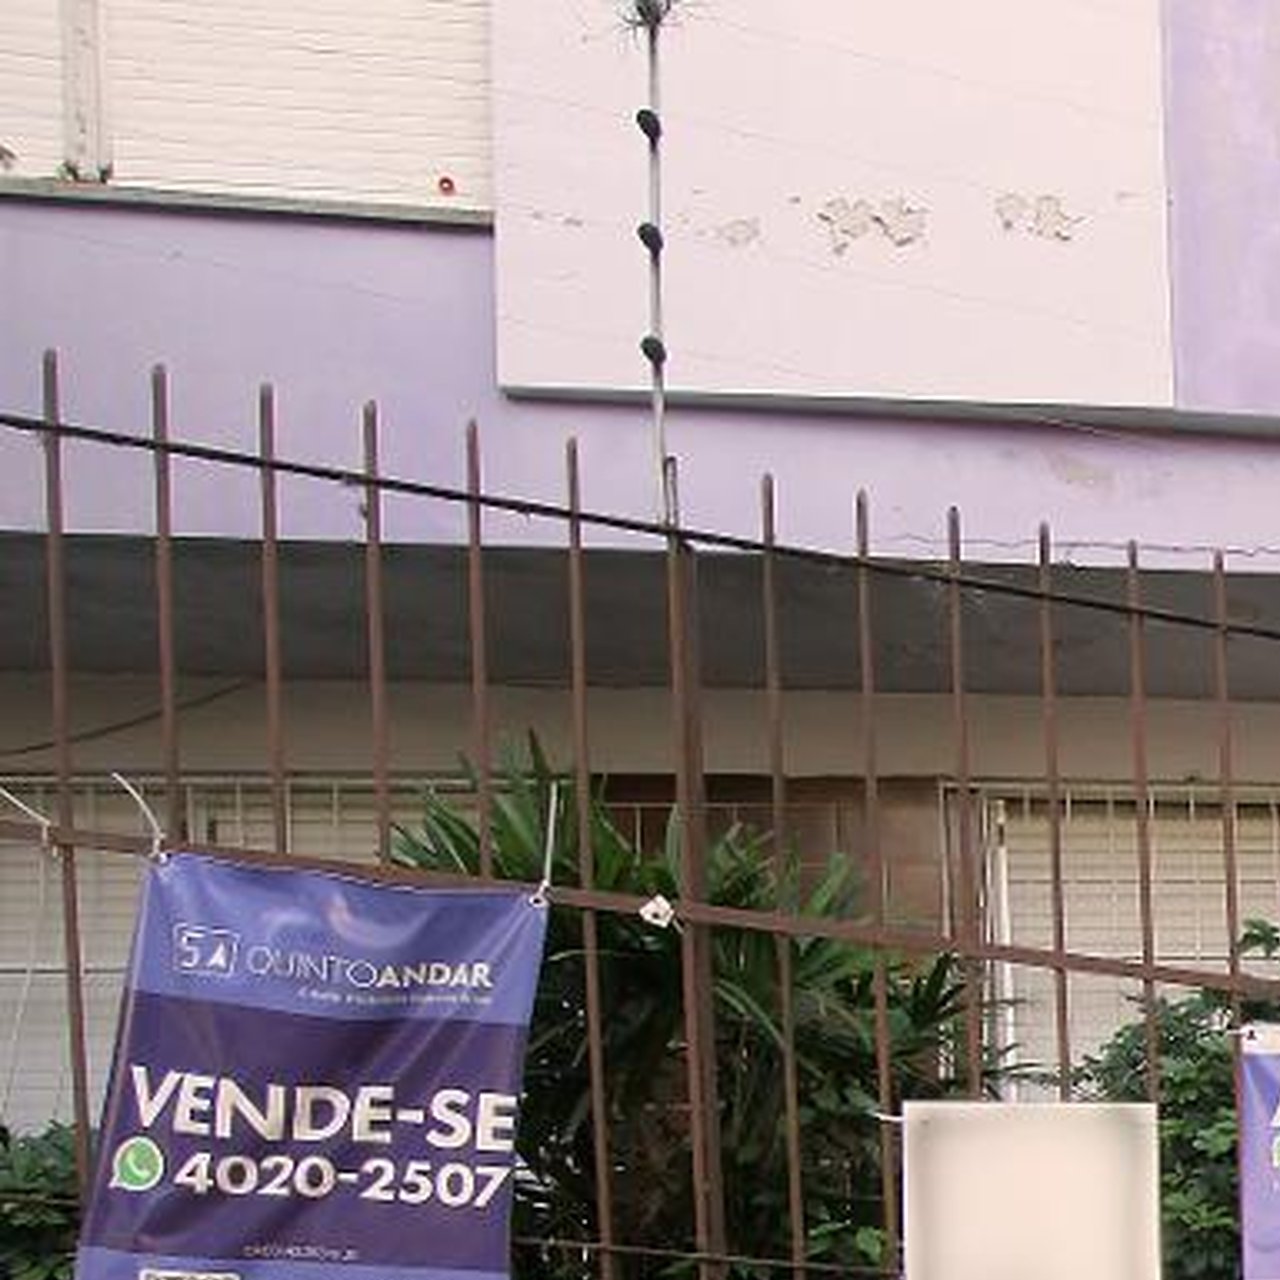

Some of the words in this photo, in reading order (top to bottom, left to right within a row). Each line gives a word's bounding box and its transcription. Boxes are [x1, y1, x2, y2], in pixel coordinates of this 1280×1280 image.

[248, 946, 494, 988] QUINTOANDAR
[129, 1064, 519, 1153] VENDE-SE
[173, 1151, 512, 1208] 4020-2507
